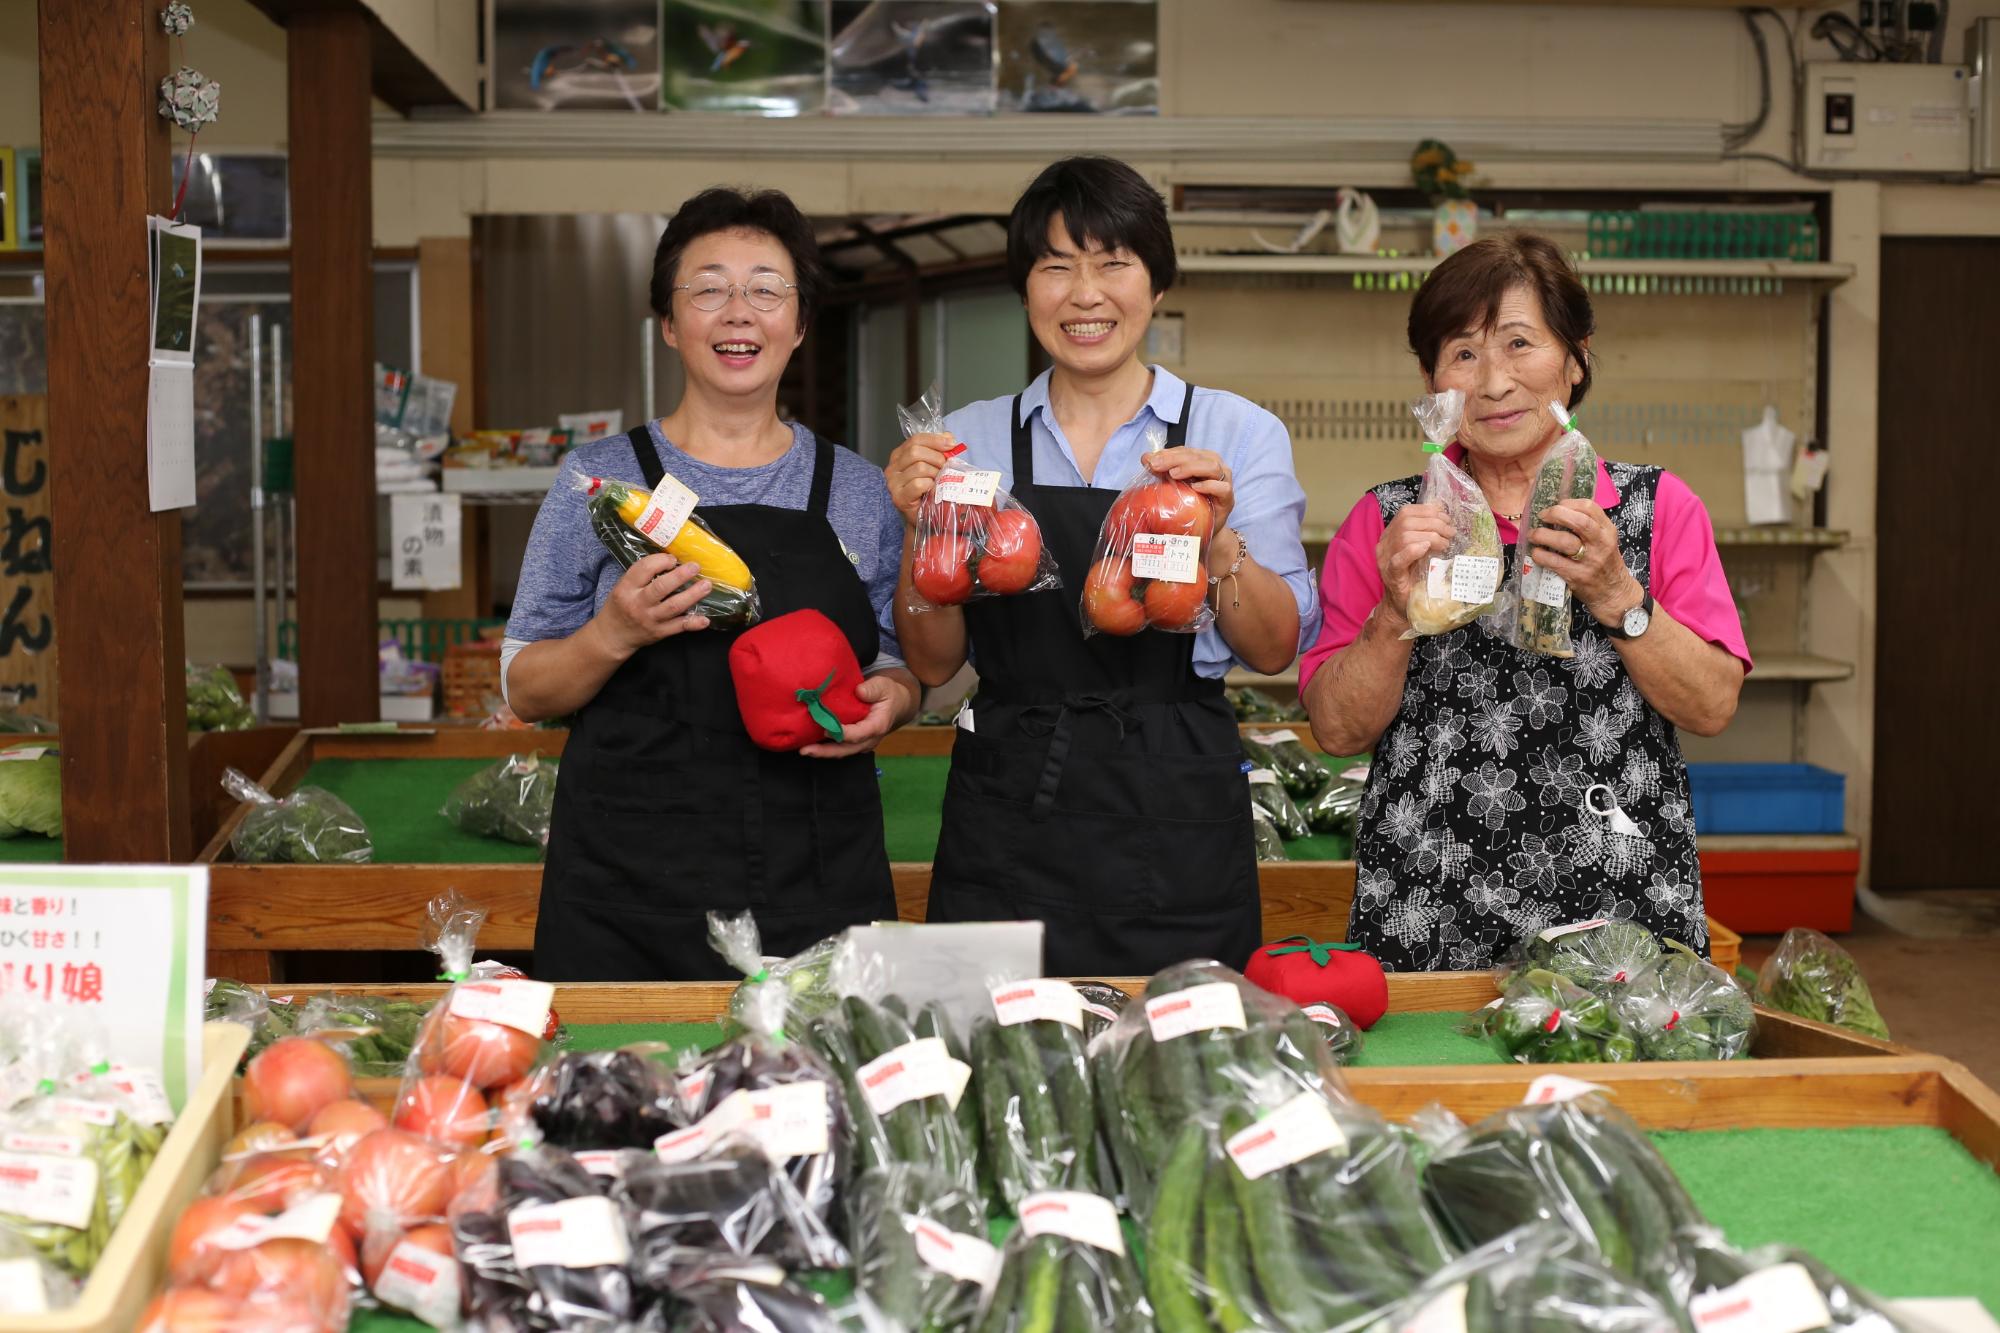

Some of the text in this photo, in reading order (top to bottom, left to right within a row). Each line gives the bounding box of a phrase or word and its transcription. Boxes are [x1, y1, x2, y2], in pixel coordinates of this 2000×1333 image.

[424, 505, 443, 546] 漬物
[1, 429, 51, 704] じねん
[402, 537, 423, 576] の素
